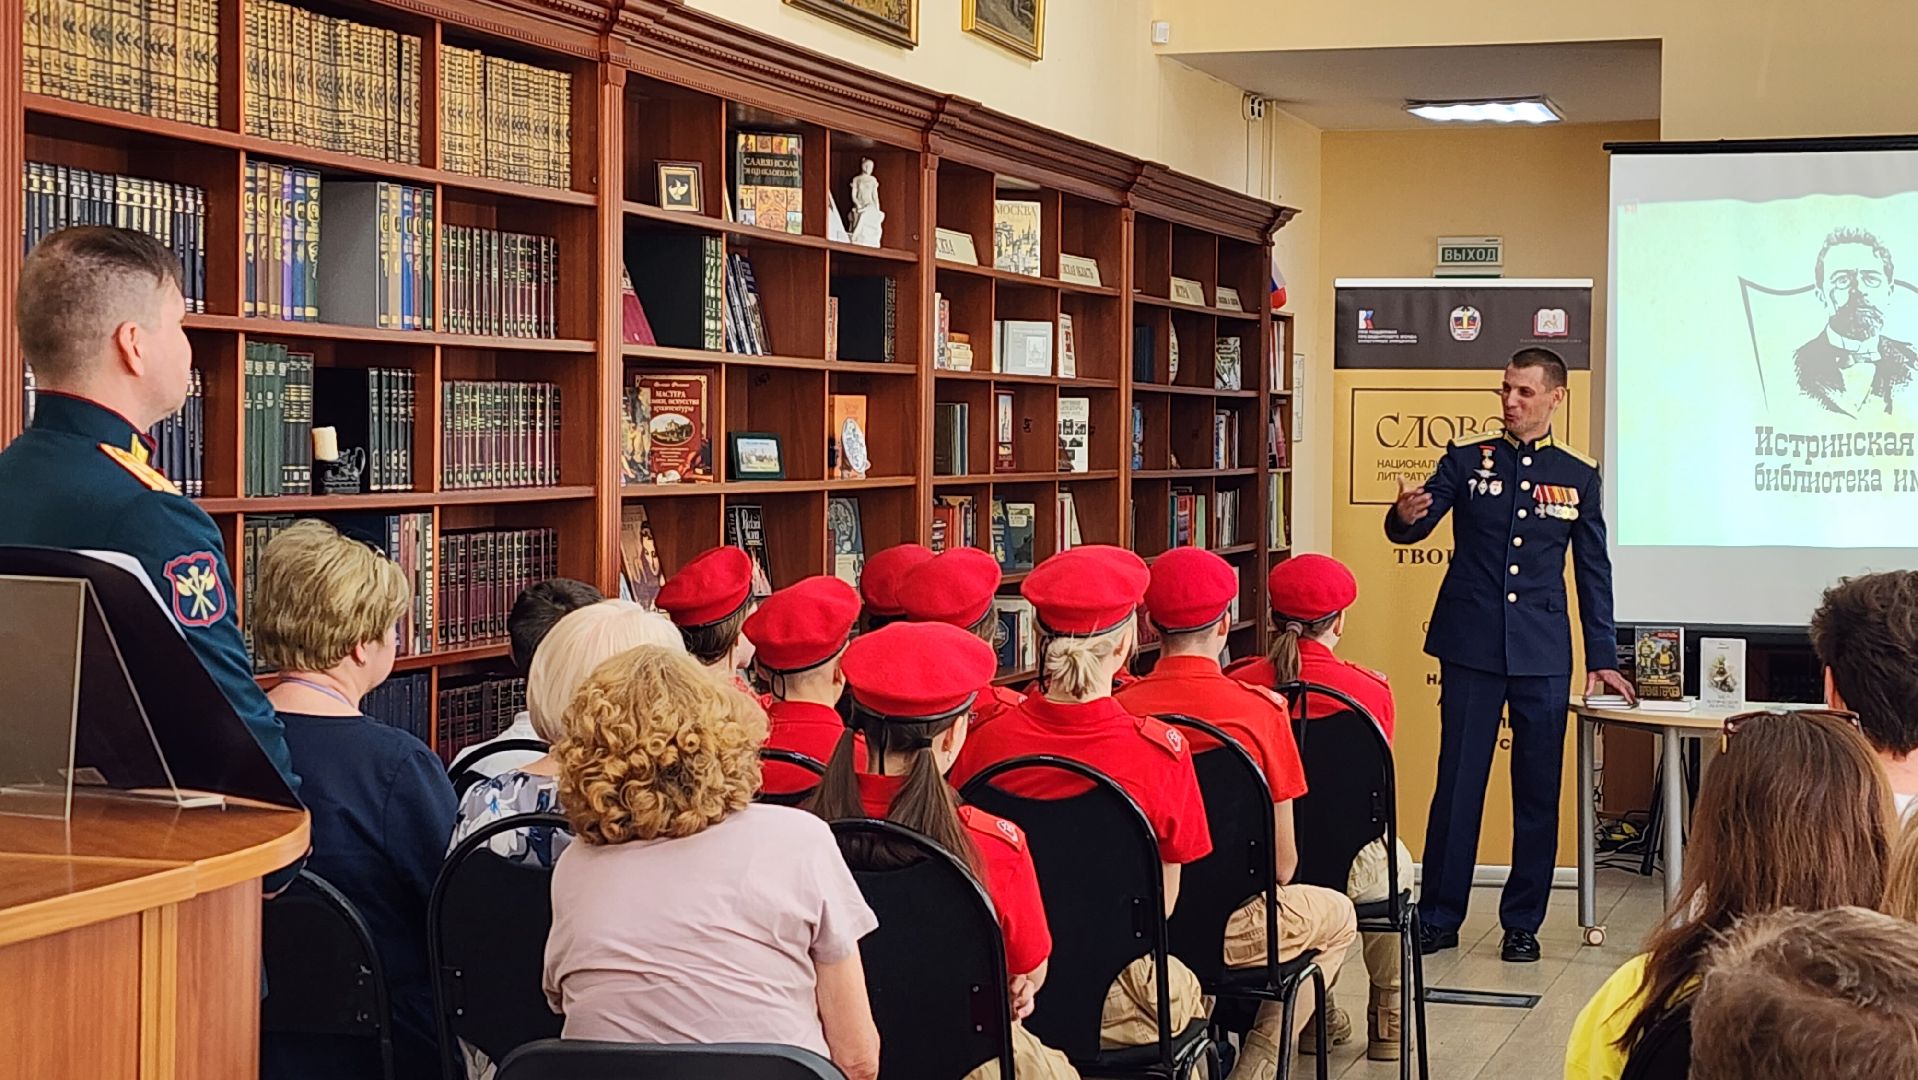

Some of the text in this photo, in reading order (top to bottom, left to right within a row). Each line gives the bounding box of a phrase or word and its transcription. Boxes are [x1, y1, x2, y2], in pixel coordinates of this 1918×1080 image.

[1444, 248, 1497, 262] ВЫХОД
[1754, 426, 1915, 465] Истринская
[1377, 459, 1439, 469] НАЦИОНАЛ
[1377, 471, 1433, 481] ЛИТРАТУ
[1754, 463, 1883, 494] библиотека
